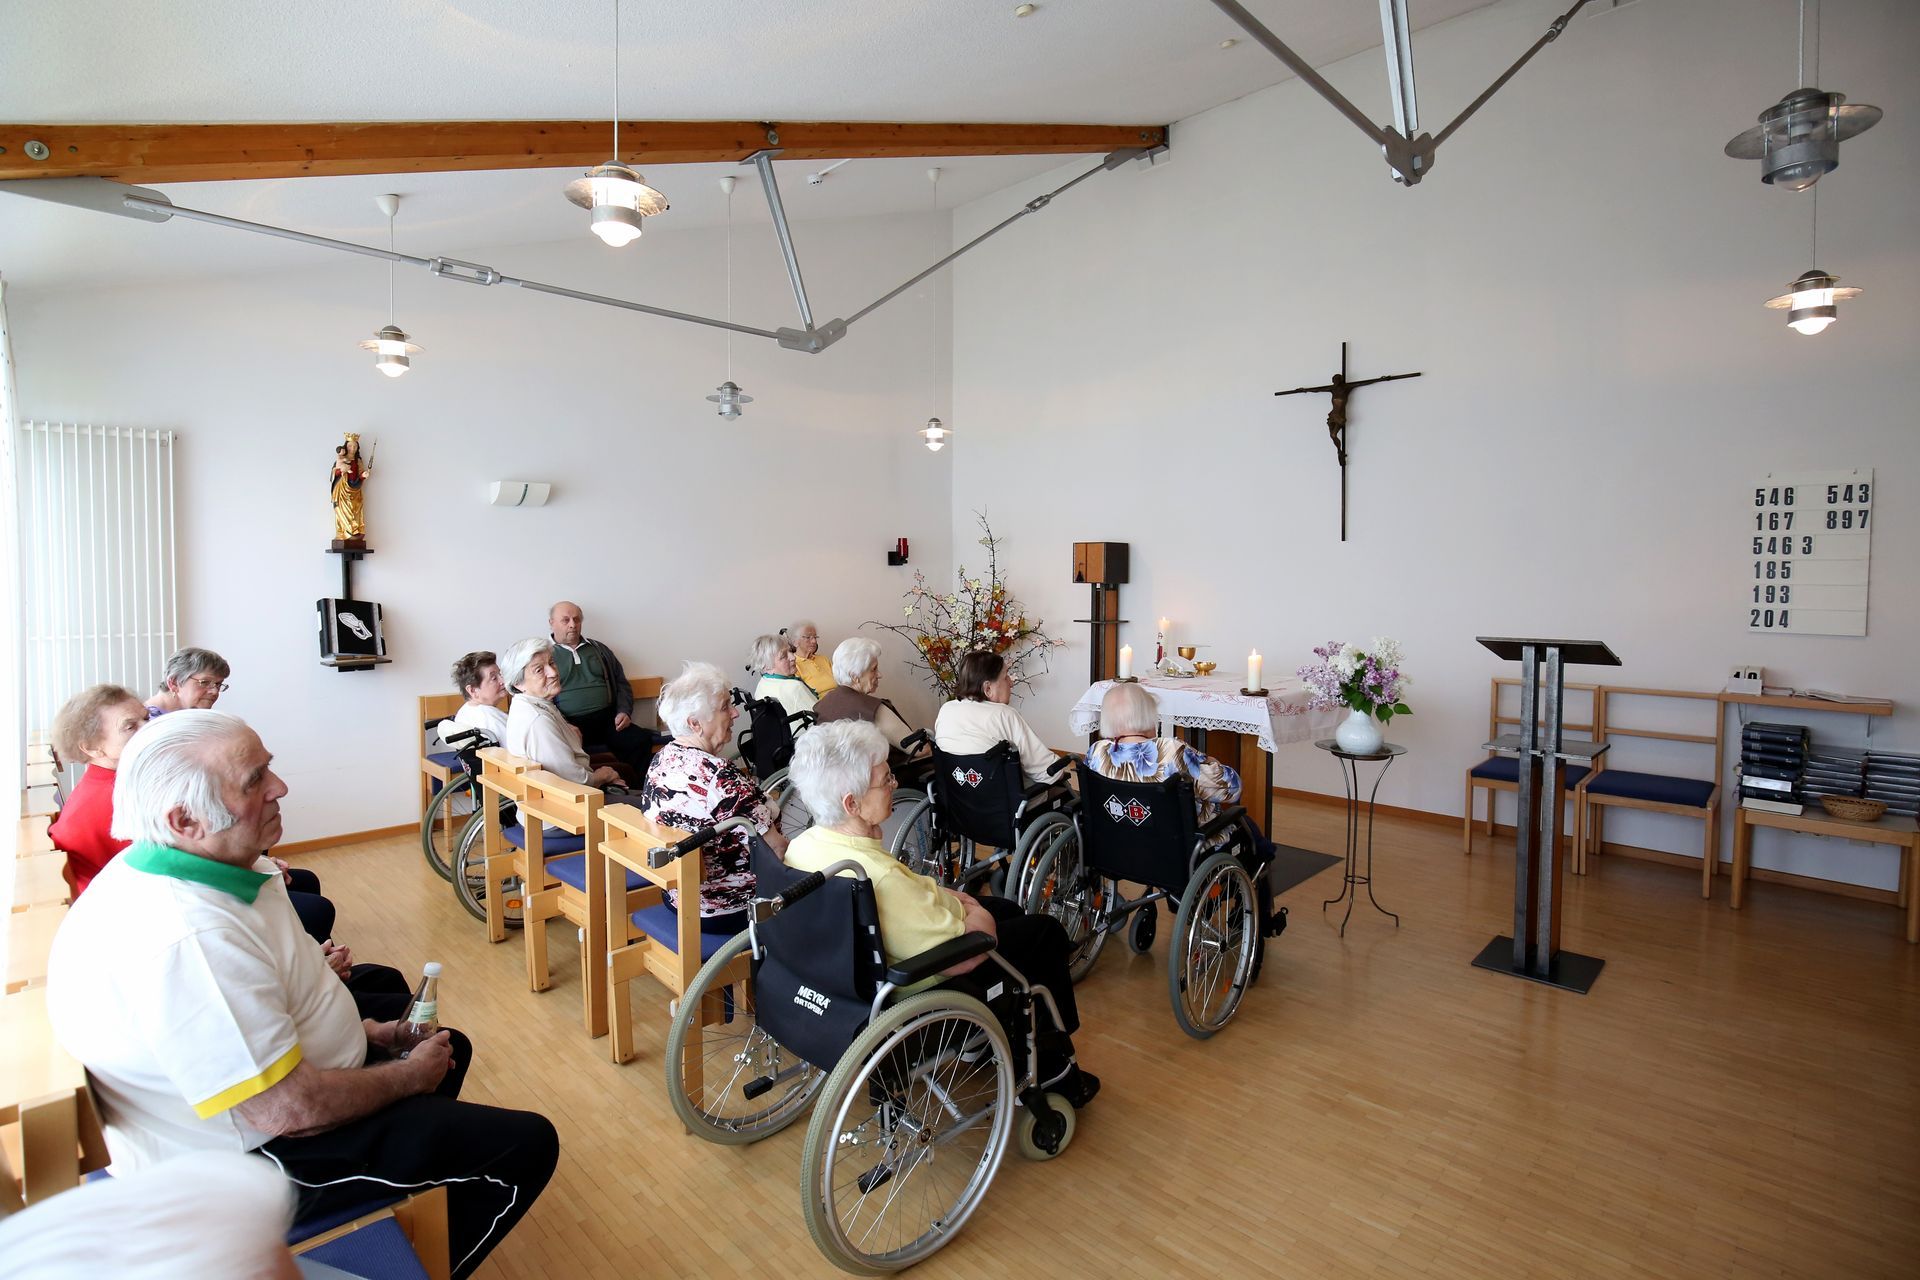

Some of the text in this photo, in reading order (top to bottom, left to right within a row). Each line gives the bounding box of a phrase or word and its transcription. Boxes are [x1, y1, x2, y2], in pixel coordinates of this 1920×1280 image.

[1755, 487, 1794, 507] 546
[1827, 484, 1870, 504] 543
[1756, 512, 1794, 530] 167
[1826, 510, 1869, 529] 897
[1752, 536, 1813, 555] 546 3
[1754, 561, 1792, 579] 185
[1753, 585, 1790, 603] 193
[1750, 609, 1789, 628] 204
